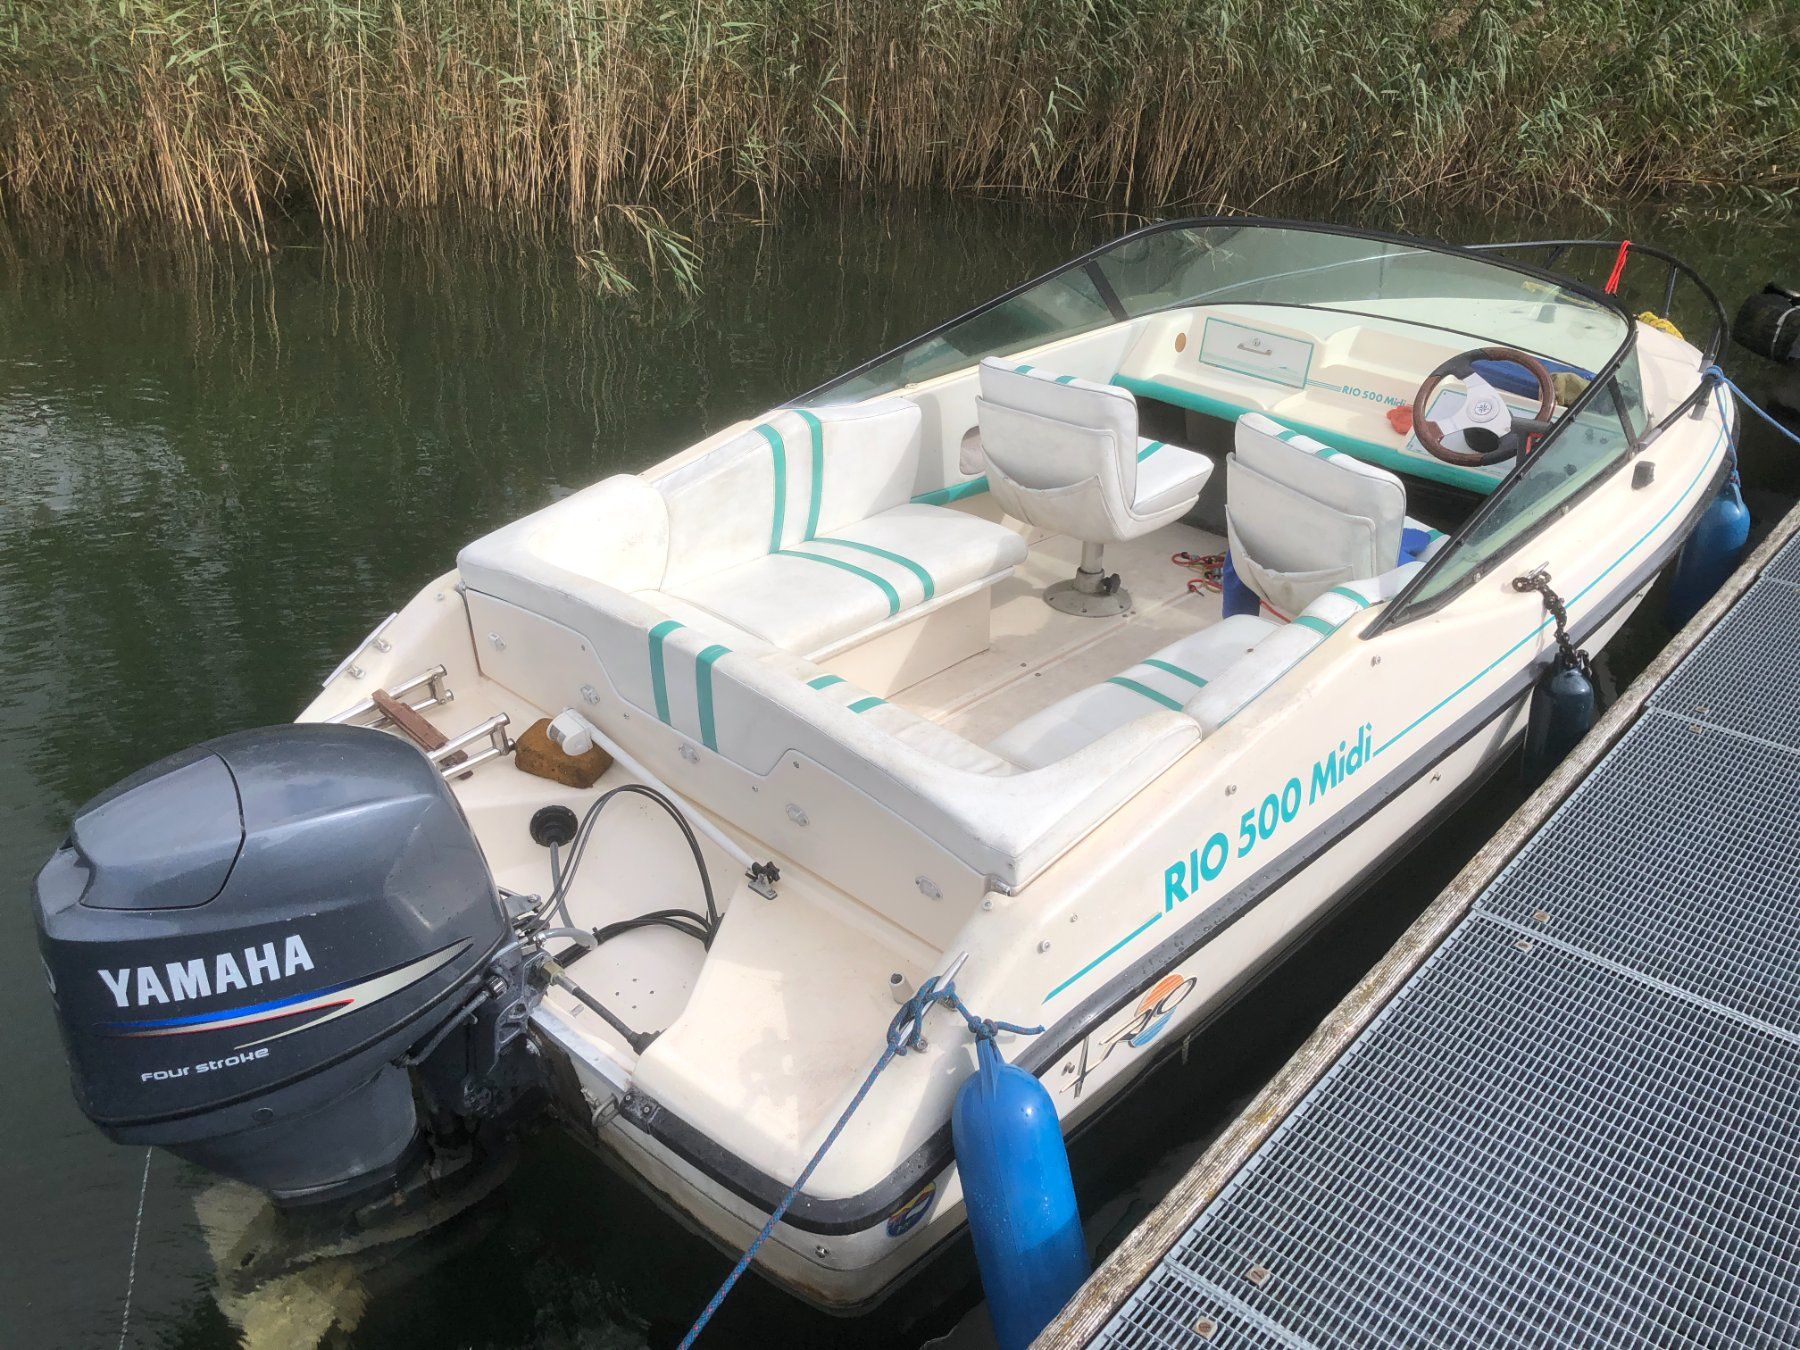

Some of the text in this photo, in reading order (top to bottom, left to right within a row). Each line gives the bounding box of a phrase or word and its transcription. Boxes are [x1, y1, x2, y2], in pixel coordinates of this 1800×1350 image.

[1342, 385, 1361, 397] RIO
[1362, 390, 1383, 403] 500
[1164, 722, 1373, 913] RIO 500 Midi
[97, 934, 315, 1008] YAMAHA
